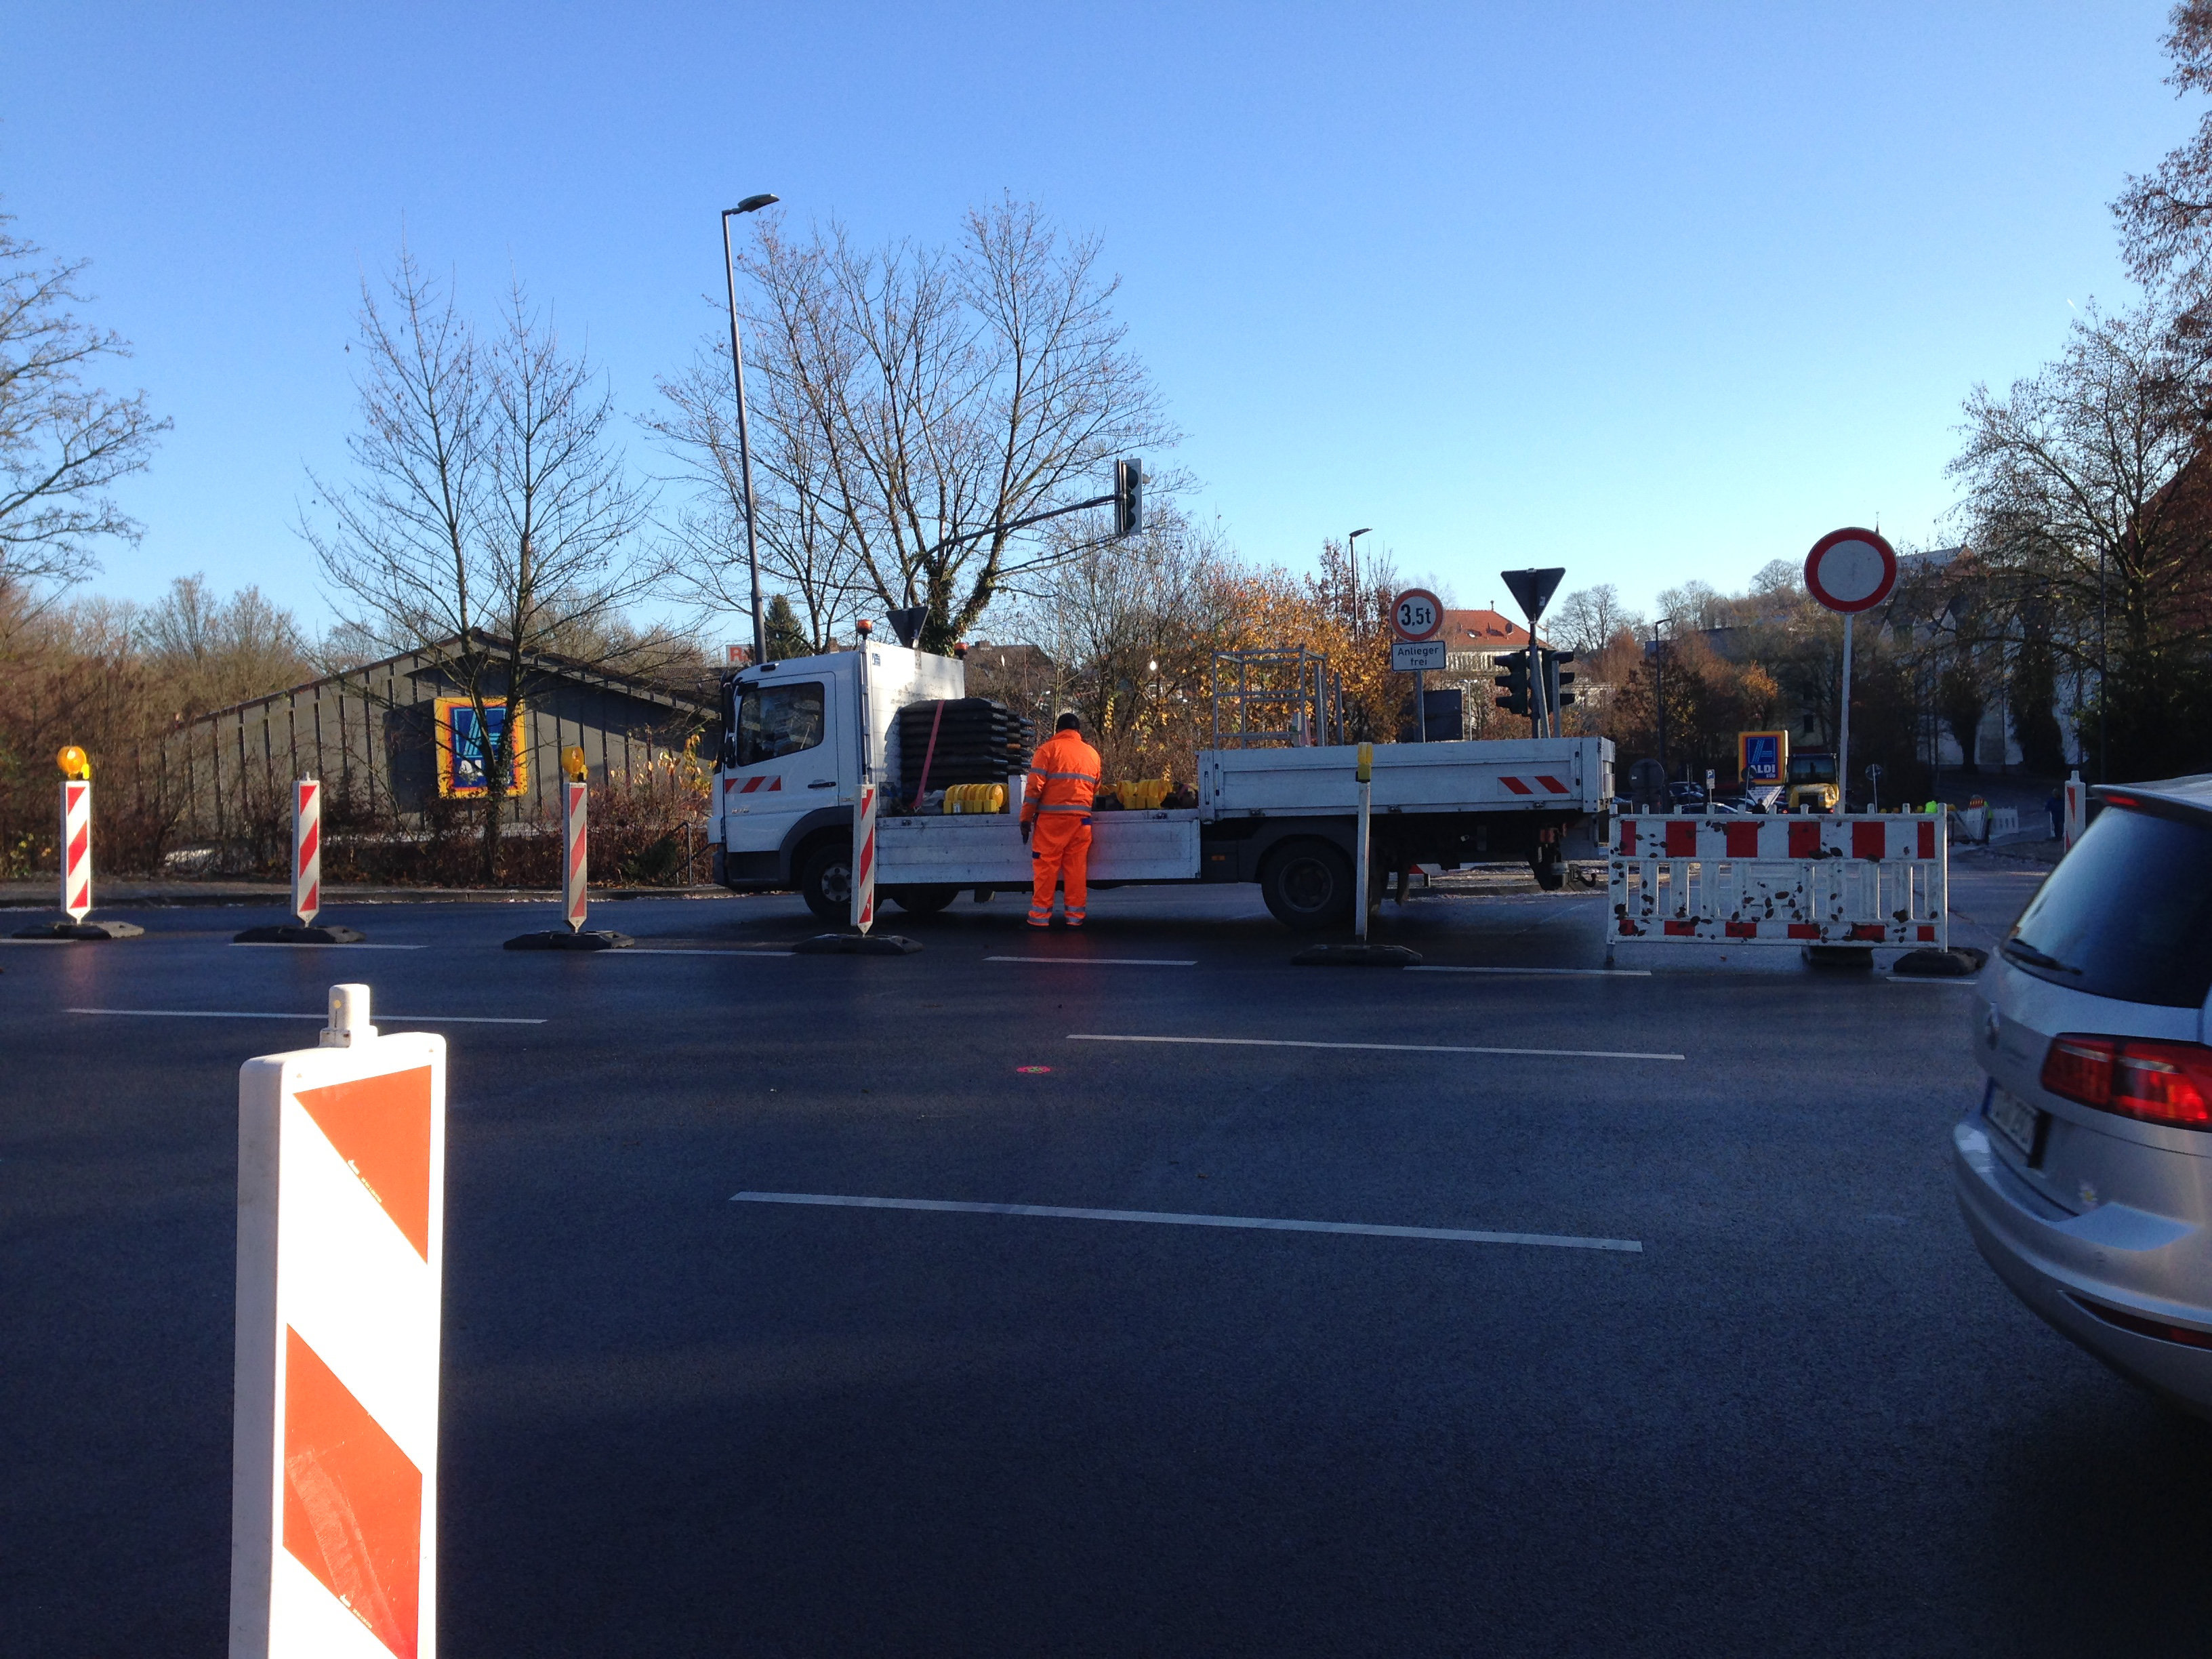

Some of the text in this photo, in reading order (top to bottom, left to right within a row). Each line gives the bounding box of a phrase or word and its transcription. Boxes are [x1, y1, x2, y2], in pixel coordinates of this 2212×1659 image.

[1400, 604, 1431, 626] 3,5t
[1397, 647, 1439, 657] Anlieger
[1410, 657, 1427, 665] frei
